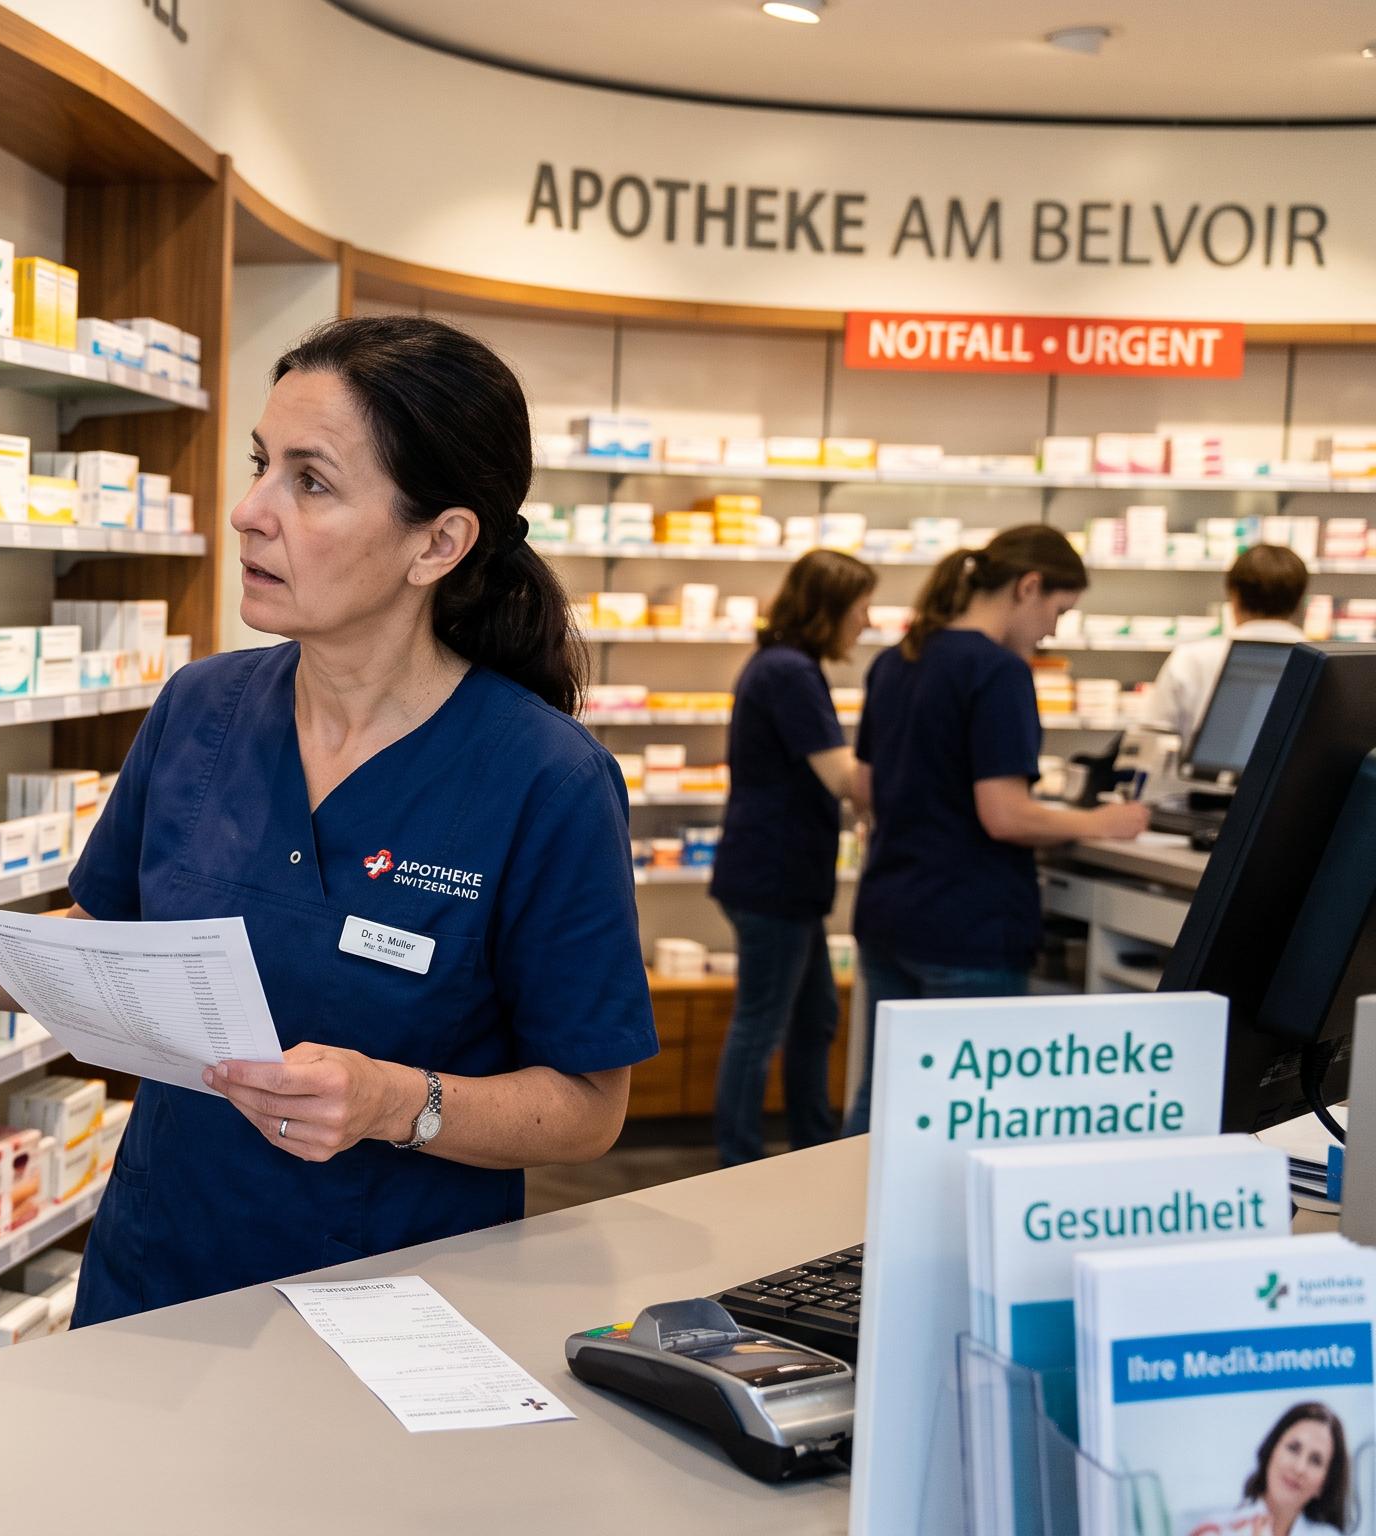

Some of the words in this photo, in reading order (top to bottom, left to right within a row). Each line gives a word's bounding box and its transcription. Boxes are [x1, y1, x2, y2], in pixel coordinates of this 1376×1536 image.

[526, 161, 866, 254] APOTHEKE
[892, 196, 1002, 261] AM
[1032, 200, 1328, 267] BELVOIR
[868, 320, 1033, 362] NOTFALL
[1067, 325, 1222, 367] URGENT
[393, 874, 479, 900] SWITZERLAND
[397, 860, 483, 887] APOTHEKE
[361, 929, 373, 940] Dr.
[377, 934, 384, 943] S.
[949, 1031, 1174, 1090] Apotheke
[948, 1090, 1184, 1140] Pharmacie
[1024, 1188, 1266, 1242] Gesundheit
[1128, 1355, 1176, 1383] Ihre
[1184, 1343, 1356, 1379] Medikamente
